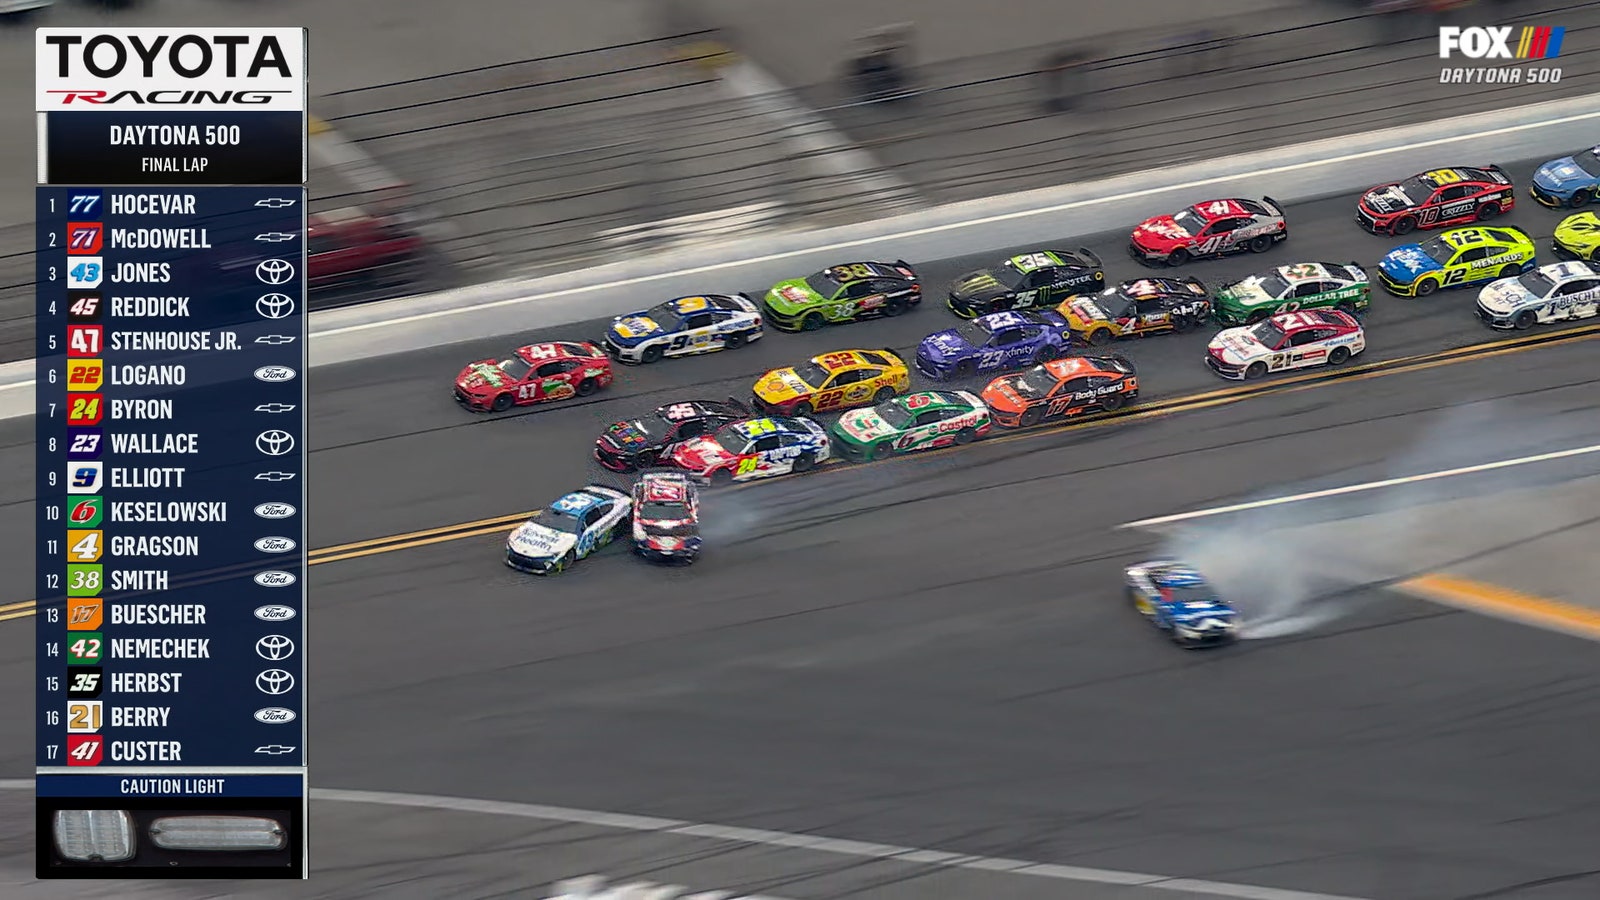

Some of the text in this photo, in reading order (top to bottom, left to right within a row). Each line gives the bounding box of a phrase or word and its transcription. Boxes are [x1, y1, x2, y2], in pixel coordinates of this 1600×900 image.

[1418, 207, 1440, 225] 10
[1199, 235, 1220, 253] 41
[1452, 230, 1484, 246] 12
[1470, 252, 1524, 270] MENARDS
[1443, 268, 1467, 285] 12
[1011, 291, 1038, 309] 35
[1302, 288, 1360, 305] DOLLAR TREE
[829, 302, 855, 320] 38
[1547, 302, 1557, 316] 1
[986, 311, 1020, 330] 23
[1121, 317, 1137, 334] 4
[671, 335, 690, 350] 9
[824, 352, 857, 370] 22
[978, 351, 1005, 369] 23
[1005, 345, 1035, 359] xfinity
[1272, 351, 1292, 369] 21
[874, 374, 898, 388] Shell
[518, 383, 537, 399] 47
[817, 391, 844, 409] 22
[1075, 382, 1124, 401] Body Guard
[939, 415, 977, 433] Castrol
[897, 433, 915, 448] 6
[737, 456, 759, 475] 24
